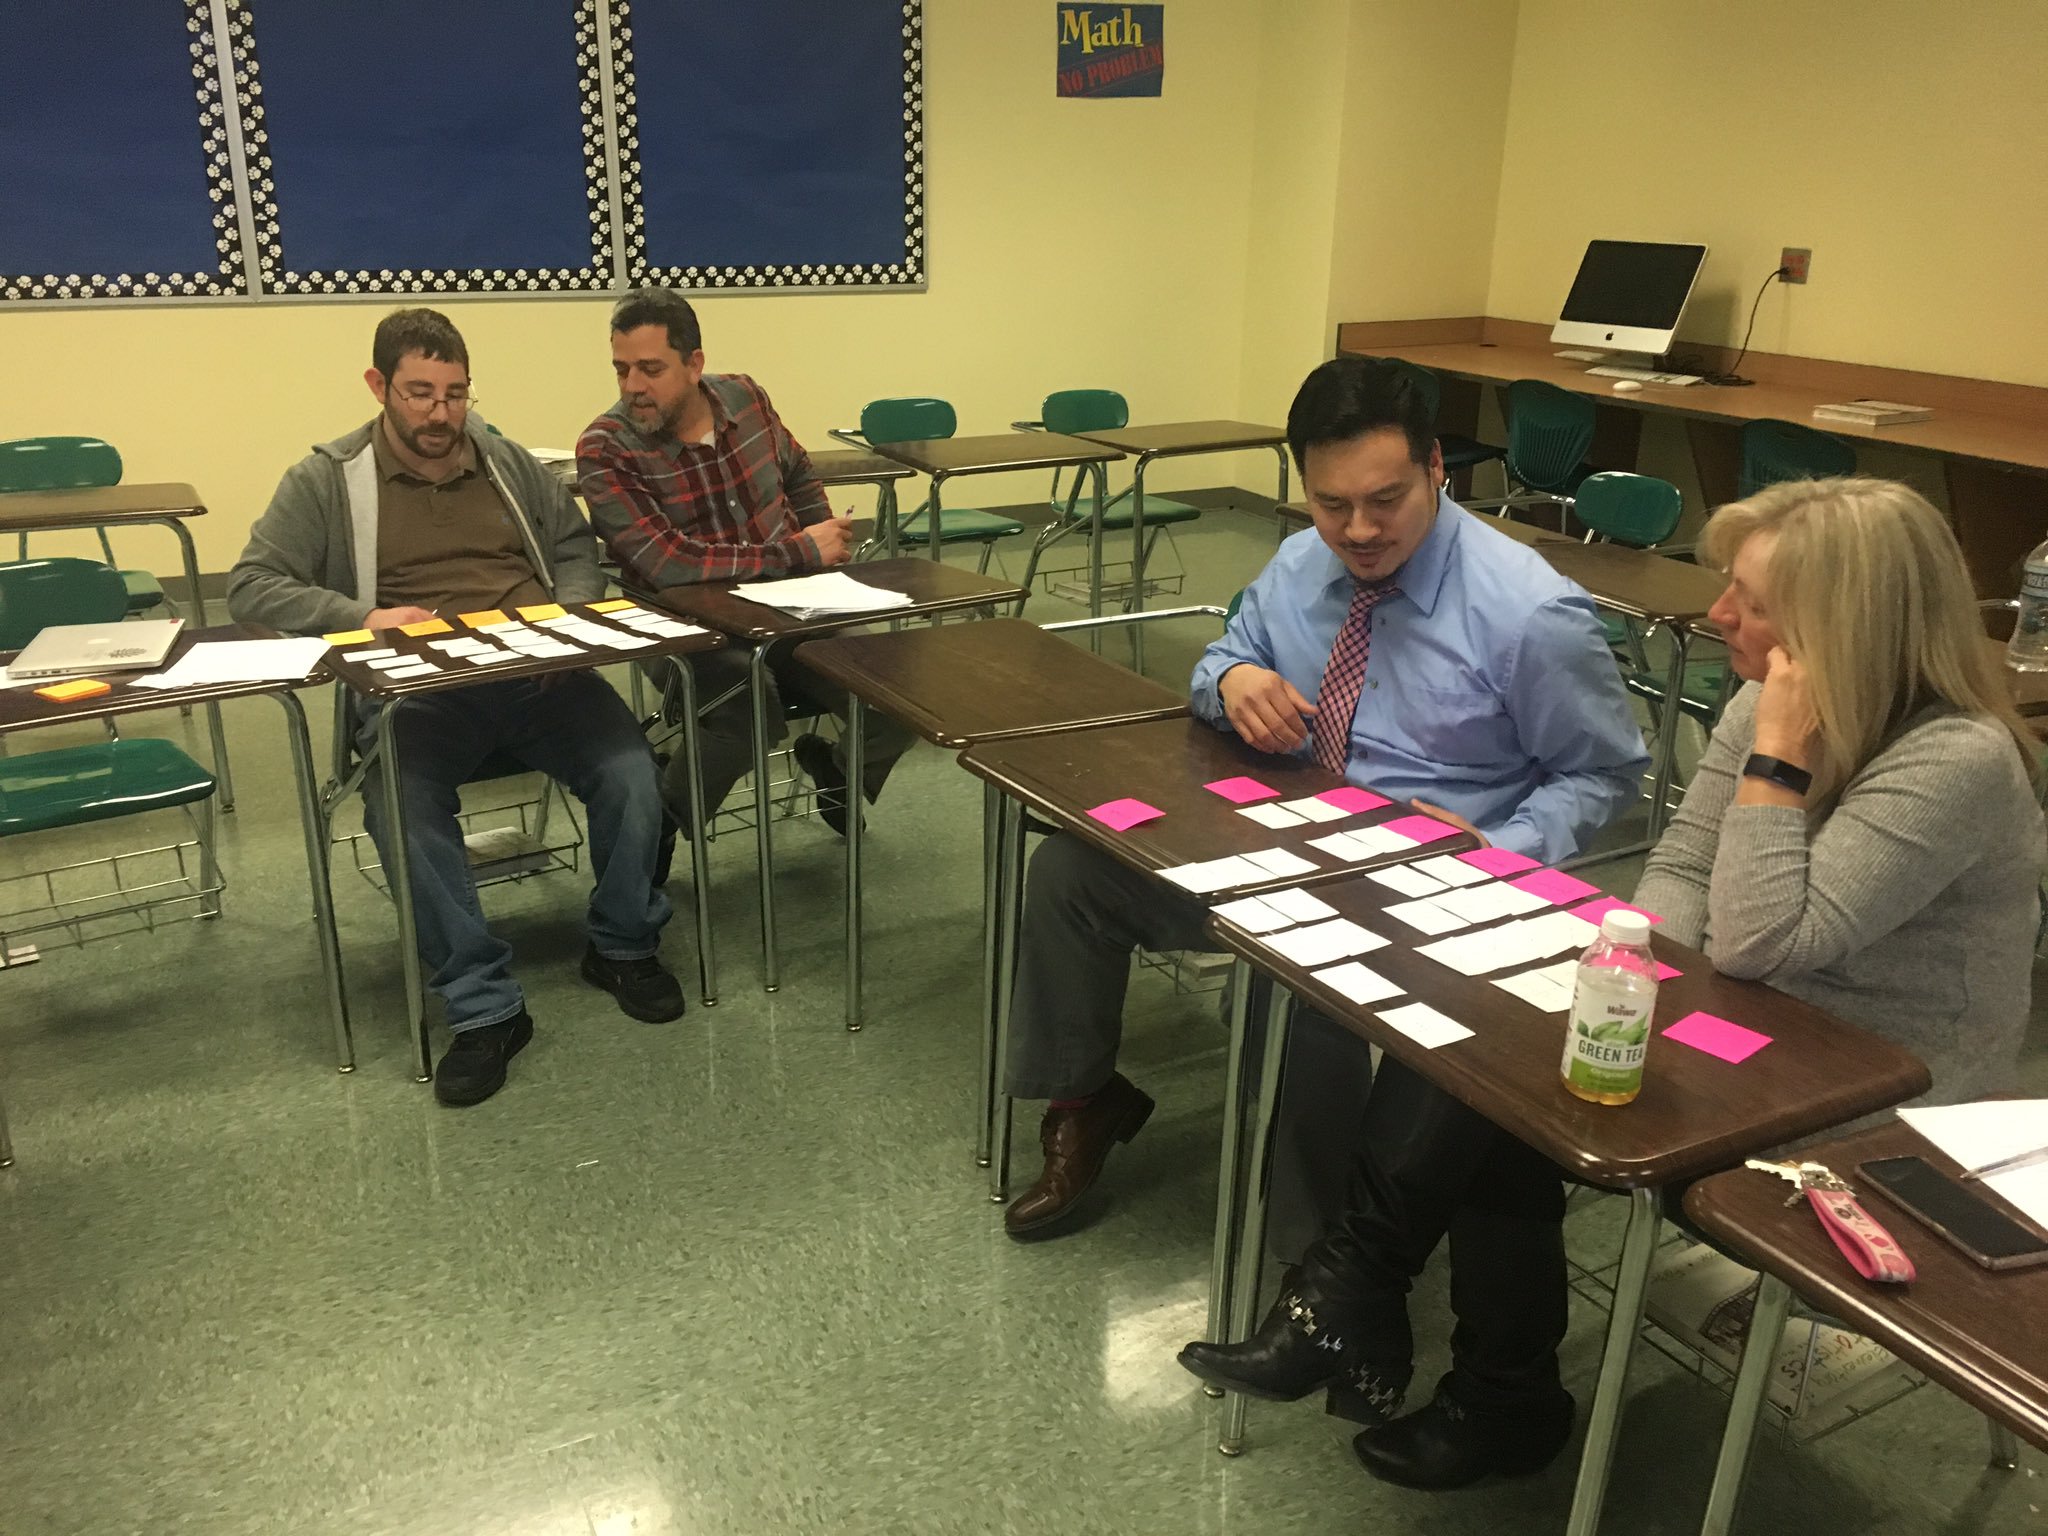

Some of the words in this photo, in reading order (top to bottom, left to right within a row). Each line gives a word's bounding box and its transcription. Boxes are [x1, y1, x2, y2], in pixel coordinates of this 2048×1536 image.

[1060, 7, 1144, 54] Math
[1059, 69, 1084, 94] NO
[1086, 45, 1163, 88] PROBLEM
[1607, 1005, 1637, 1017] Wawa
[1578, 1039, 1622, 1063] GREEN
[1625, 1047, 1643, 1063] TEA
